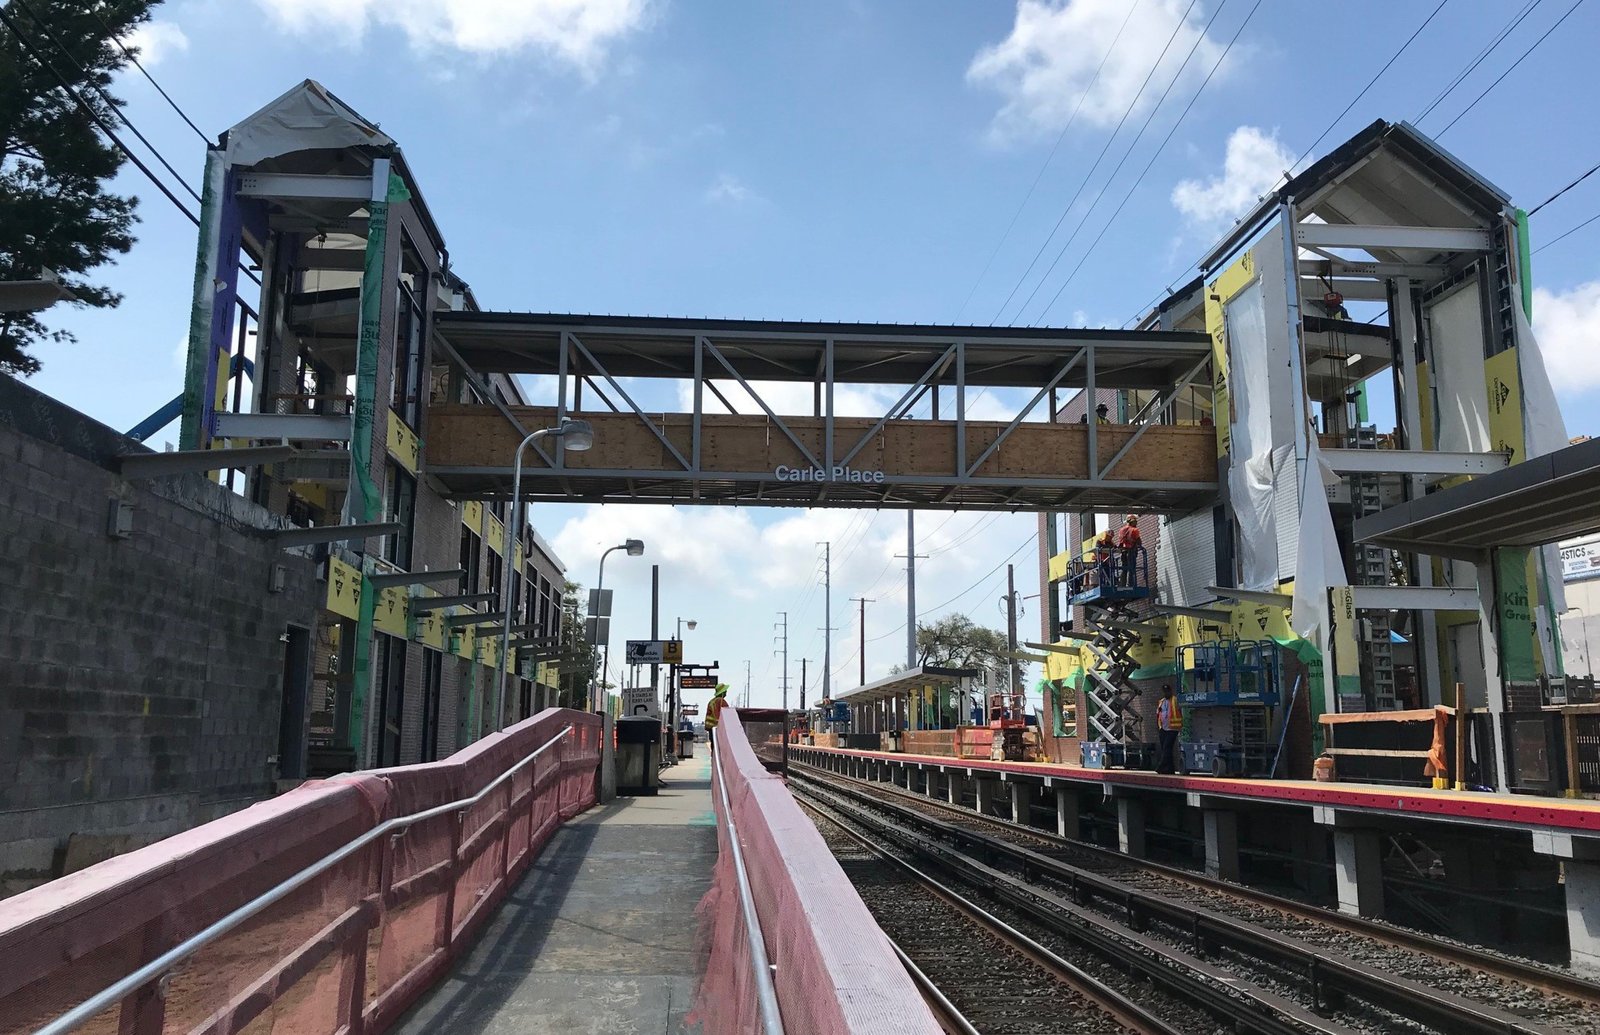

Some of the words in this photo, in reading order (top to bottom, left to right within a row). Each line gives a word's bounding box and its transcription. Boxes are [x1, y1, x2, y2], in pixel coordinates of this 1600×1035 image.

[775, 465, 826, 482] Carle
[831, 466, 885, 483] Place
[1560, 547, 1586, 560] ASTICS
[1504, 592, 1529, 606] Kin
[669, 643, 677, 653] B
